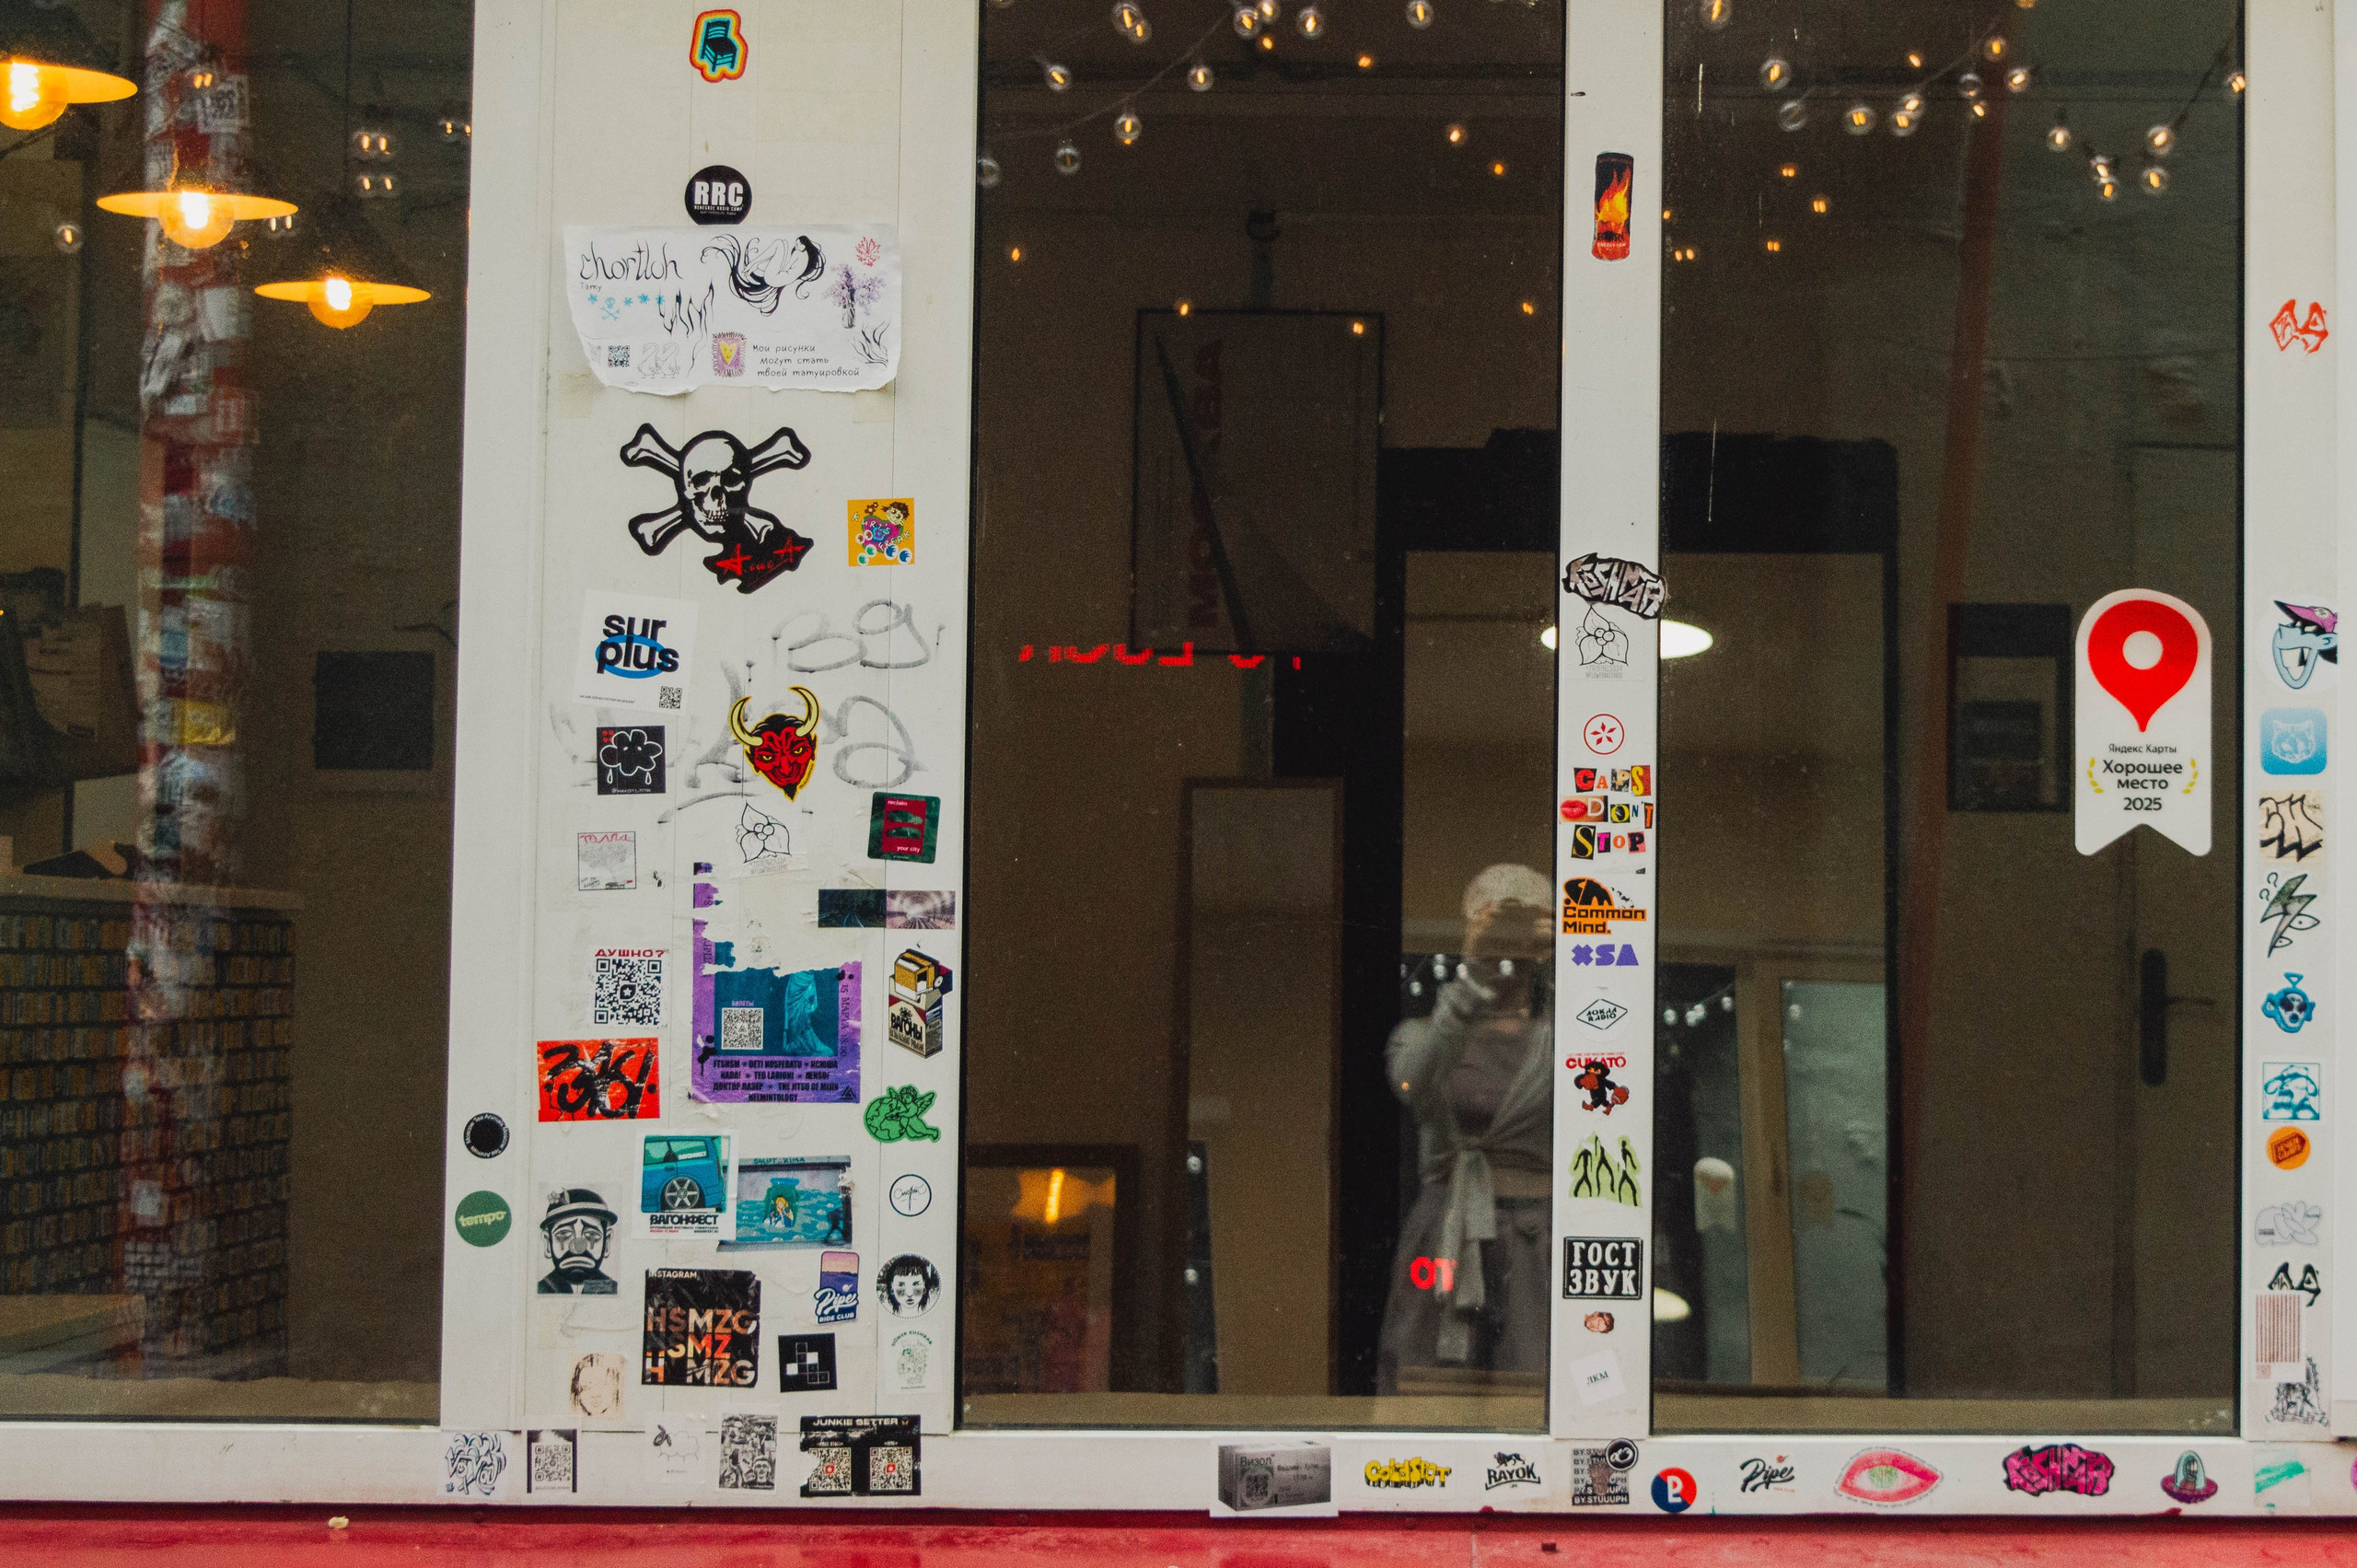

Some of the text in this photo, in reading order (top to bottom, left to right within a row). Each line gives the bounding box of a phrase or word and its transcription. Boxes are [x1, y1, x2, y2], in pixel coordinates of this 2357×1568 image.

[694, 180, 744, 207] RRC
[752, 344, 816, 354] Мои рисунки
[757, 366, 860, 378] твоей татуировкой
[602, 614, 668, 642] sur
[596, 635, 680, 675] plus
[2107, 743, 2177, 755] Яндекс Карты
[2102, 759, 2184, 776] Хорошее
[1573, 765, 1648, 796] CAPS
[2117, 776, 2169, 790] место
[2122, 797, 2163, 811] 2025
[1587, 796, 1654, 829] DON'T
[1573, 825, 1646, 859] STOP
[909, 845, 921, 854] city
[1562, 906, 1646, 920] Common
[1562, 921, 1612, 935] Mind.
[595, 948, 666, 958] ДУШНО?
[1587, 1013, 1617, 1022] RADIO
[459, 1210, 507, 1229] tempo
[649, 1214, 719, 1225] ВАГОНФЕСТ
[1572, 1241, 1637, 1267] ГОСТ
[1568, 1269, 1637, 1295] ЗВУК
[814, 1287, 858, 1316] Pipe
[819, 1312, 854, 1323] RIDE CLUB
[1586, 1371, 1609, 1385] ЛКМ
[812, 1418, 853, 1426] JUNKIE
[1486, 1462, 1536, 1484] RAYOK
[1738, 1457, 1795, 1493] Pipe
